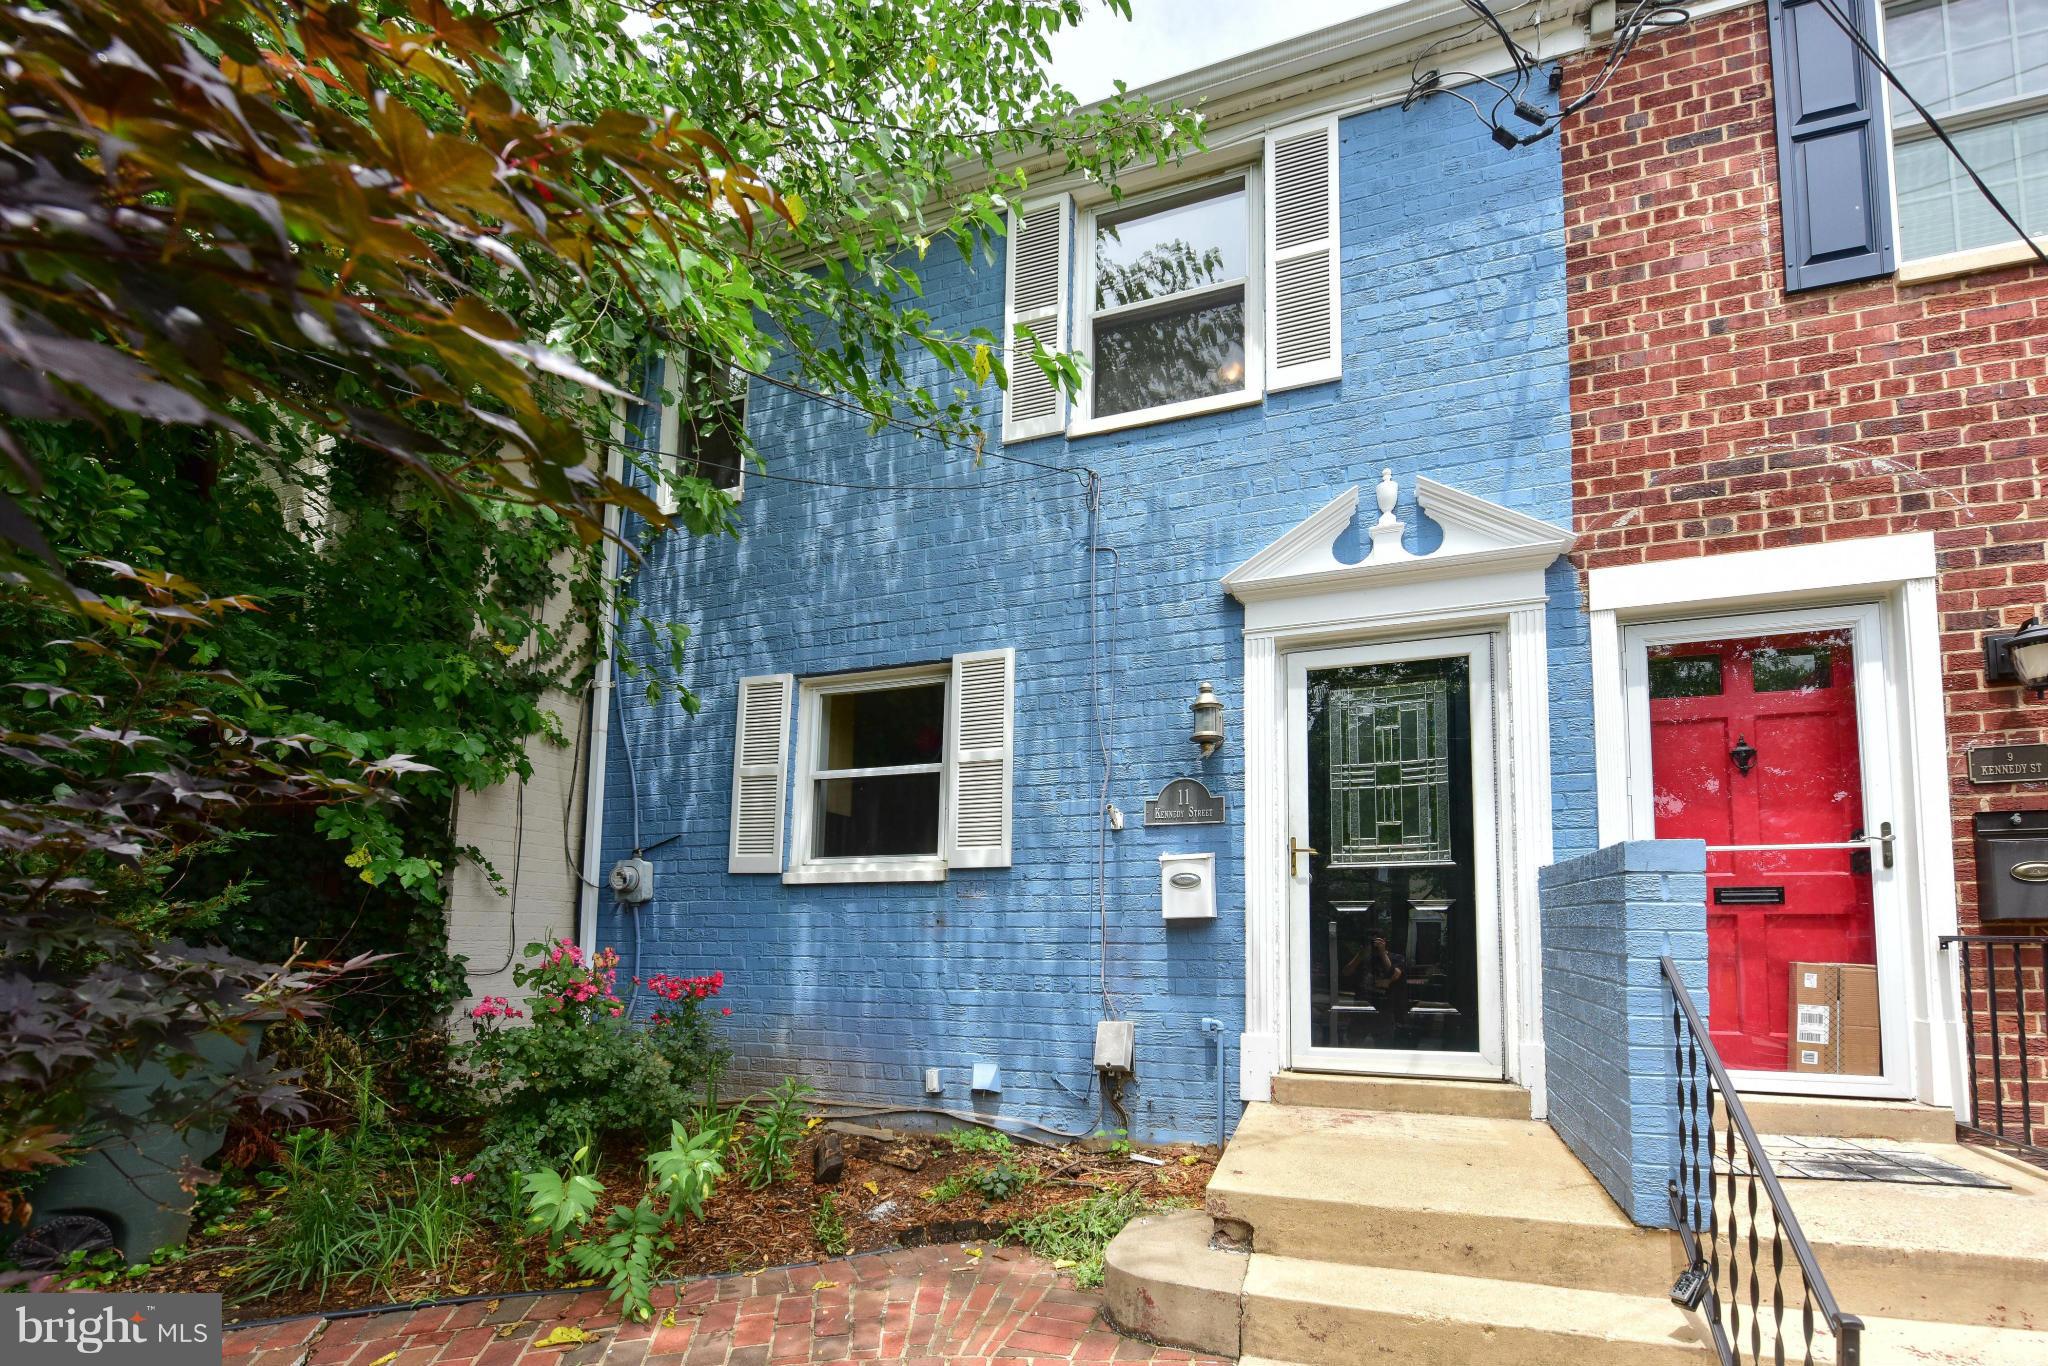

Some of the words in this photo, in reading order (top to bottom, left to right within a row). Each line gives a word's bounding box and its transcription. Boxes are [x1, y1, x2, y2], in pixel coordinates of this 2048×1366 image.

[2007, 752, 2014, 761] 9
[1981, 763, 2027, 776] KENNEDY
[2030, 762, 2042, 773] ST
[1178, 788, 1190, 805] 11
[1154, 807, 1185, 819] KENNEDY
[1188, 806, 1213, 818] STREET
